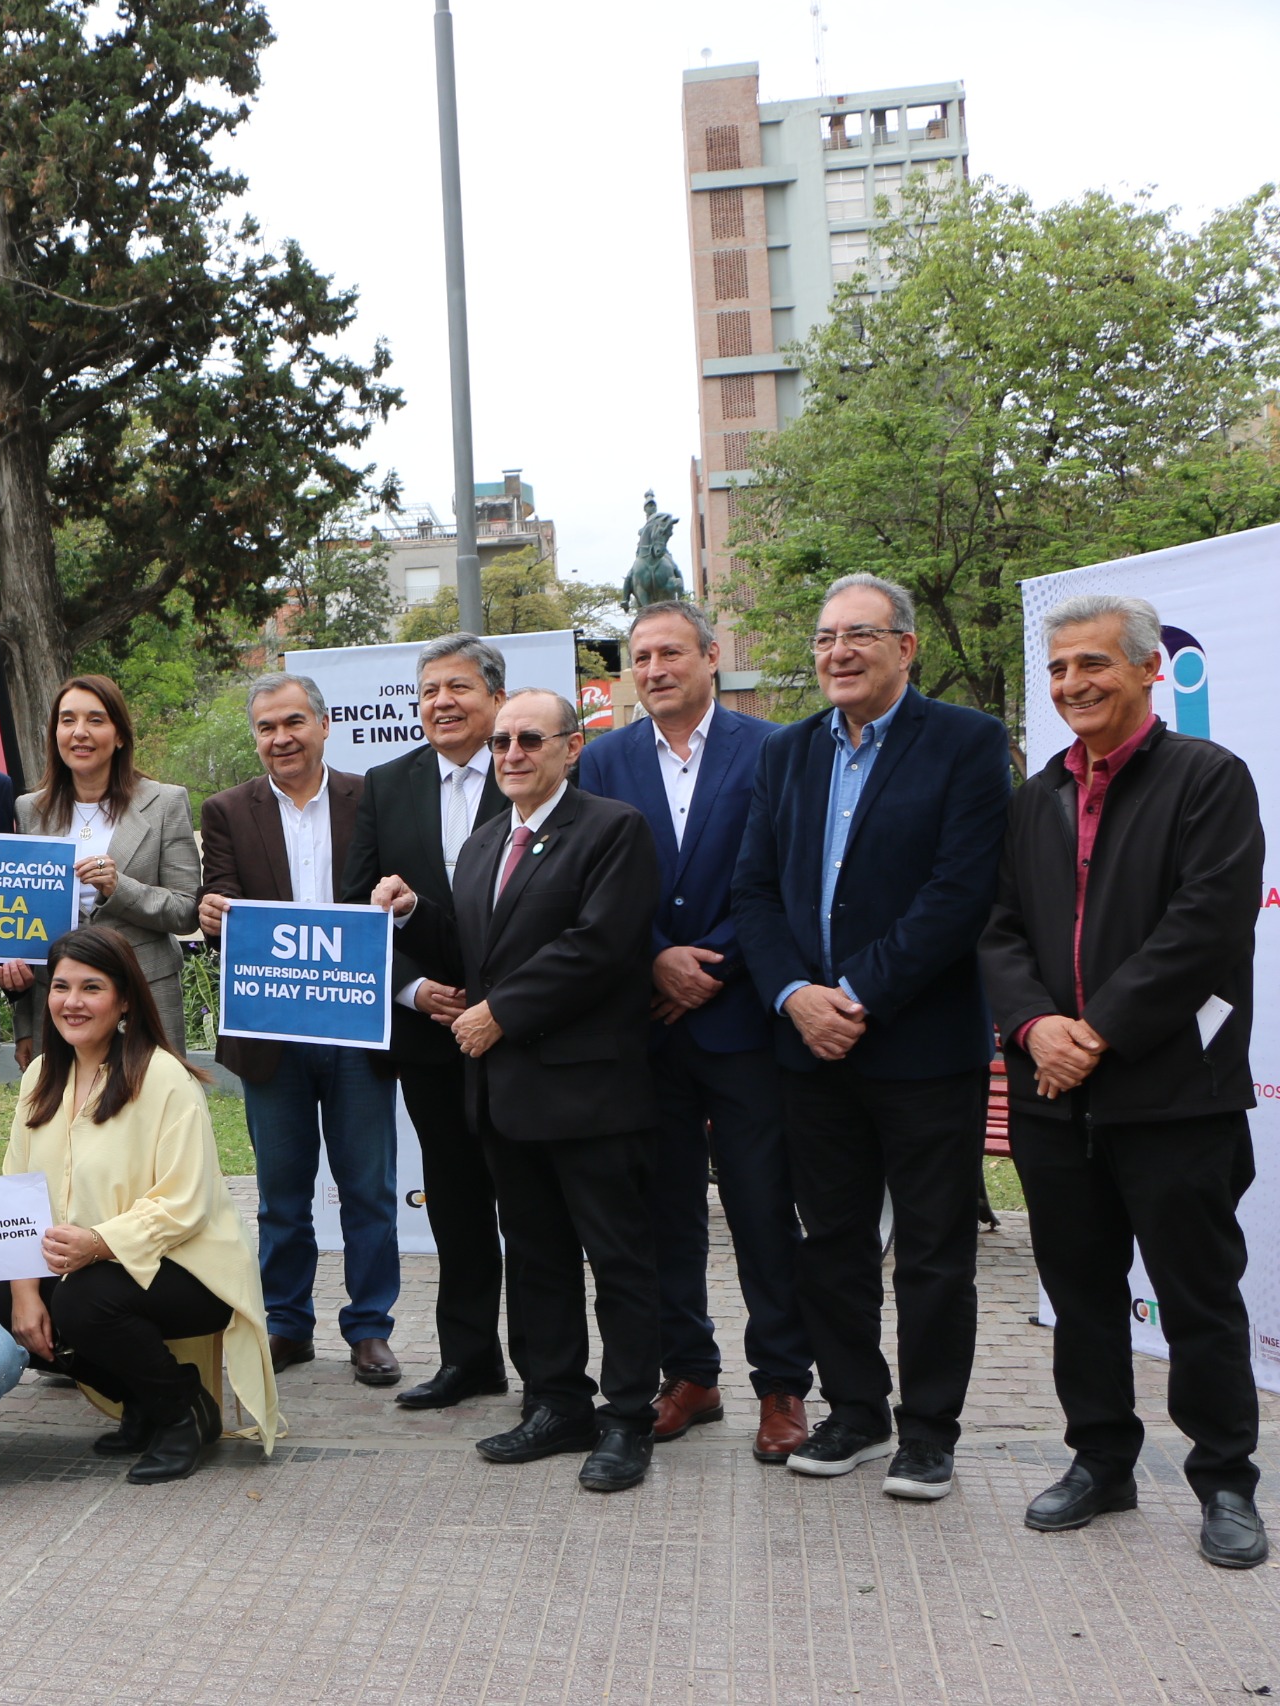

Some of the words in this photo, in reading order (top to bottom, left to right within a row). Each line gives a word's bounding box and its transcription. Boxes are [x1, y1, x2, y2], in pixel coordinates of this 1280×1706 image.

[379, 684, 418, 697] JORN
[327, 703, 403, 722] ENCIA,
[352, 728, 365, 744] E
[370, 725, 425, 743] INNO
[270, 923, 343, 963] SIN
[234, 964, 319, 981] UNIVERSIDAD
[322, 968, 376, 985] PÚBLICA
[233, 981, 260, 996] NO
[264, 983, 301, 1000] HAY
[305, 986, 376, 1005] FUTURO
[1260, 1334, 1280, 1348] UNSE
